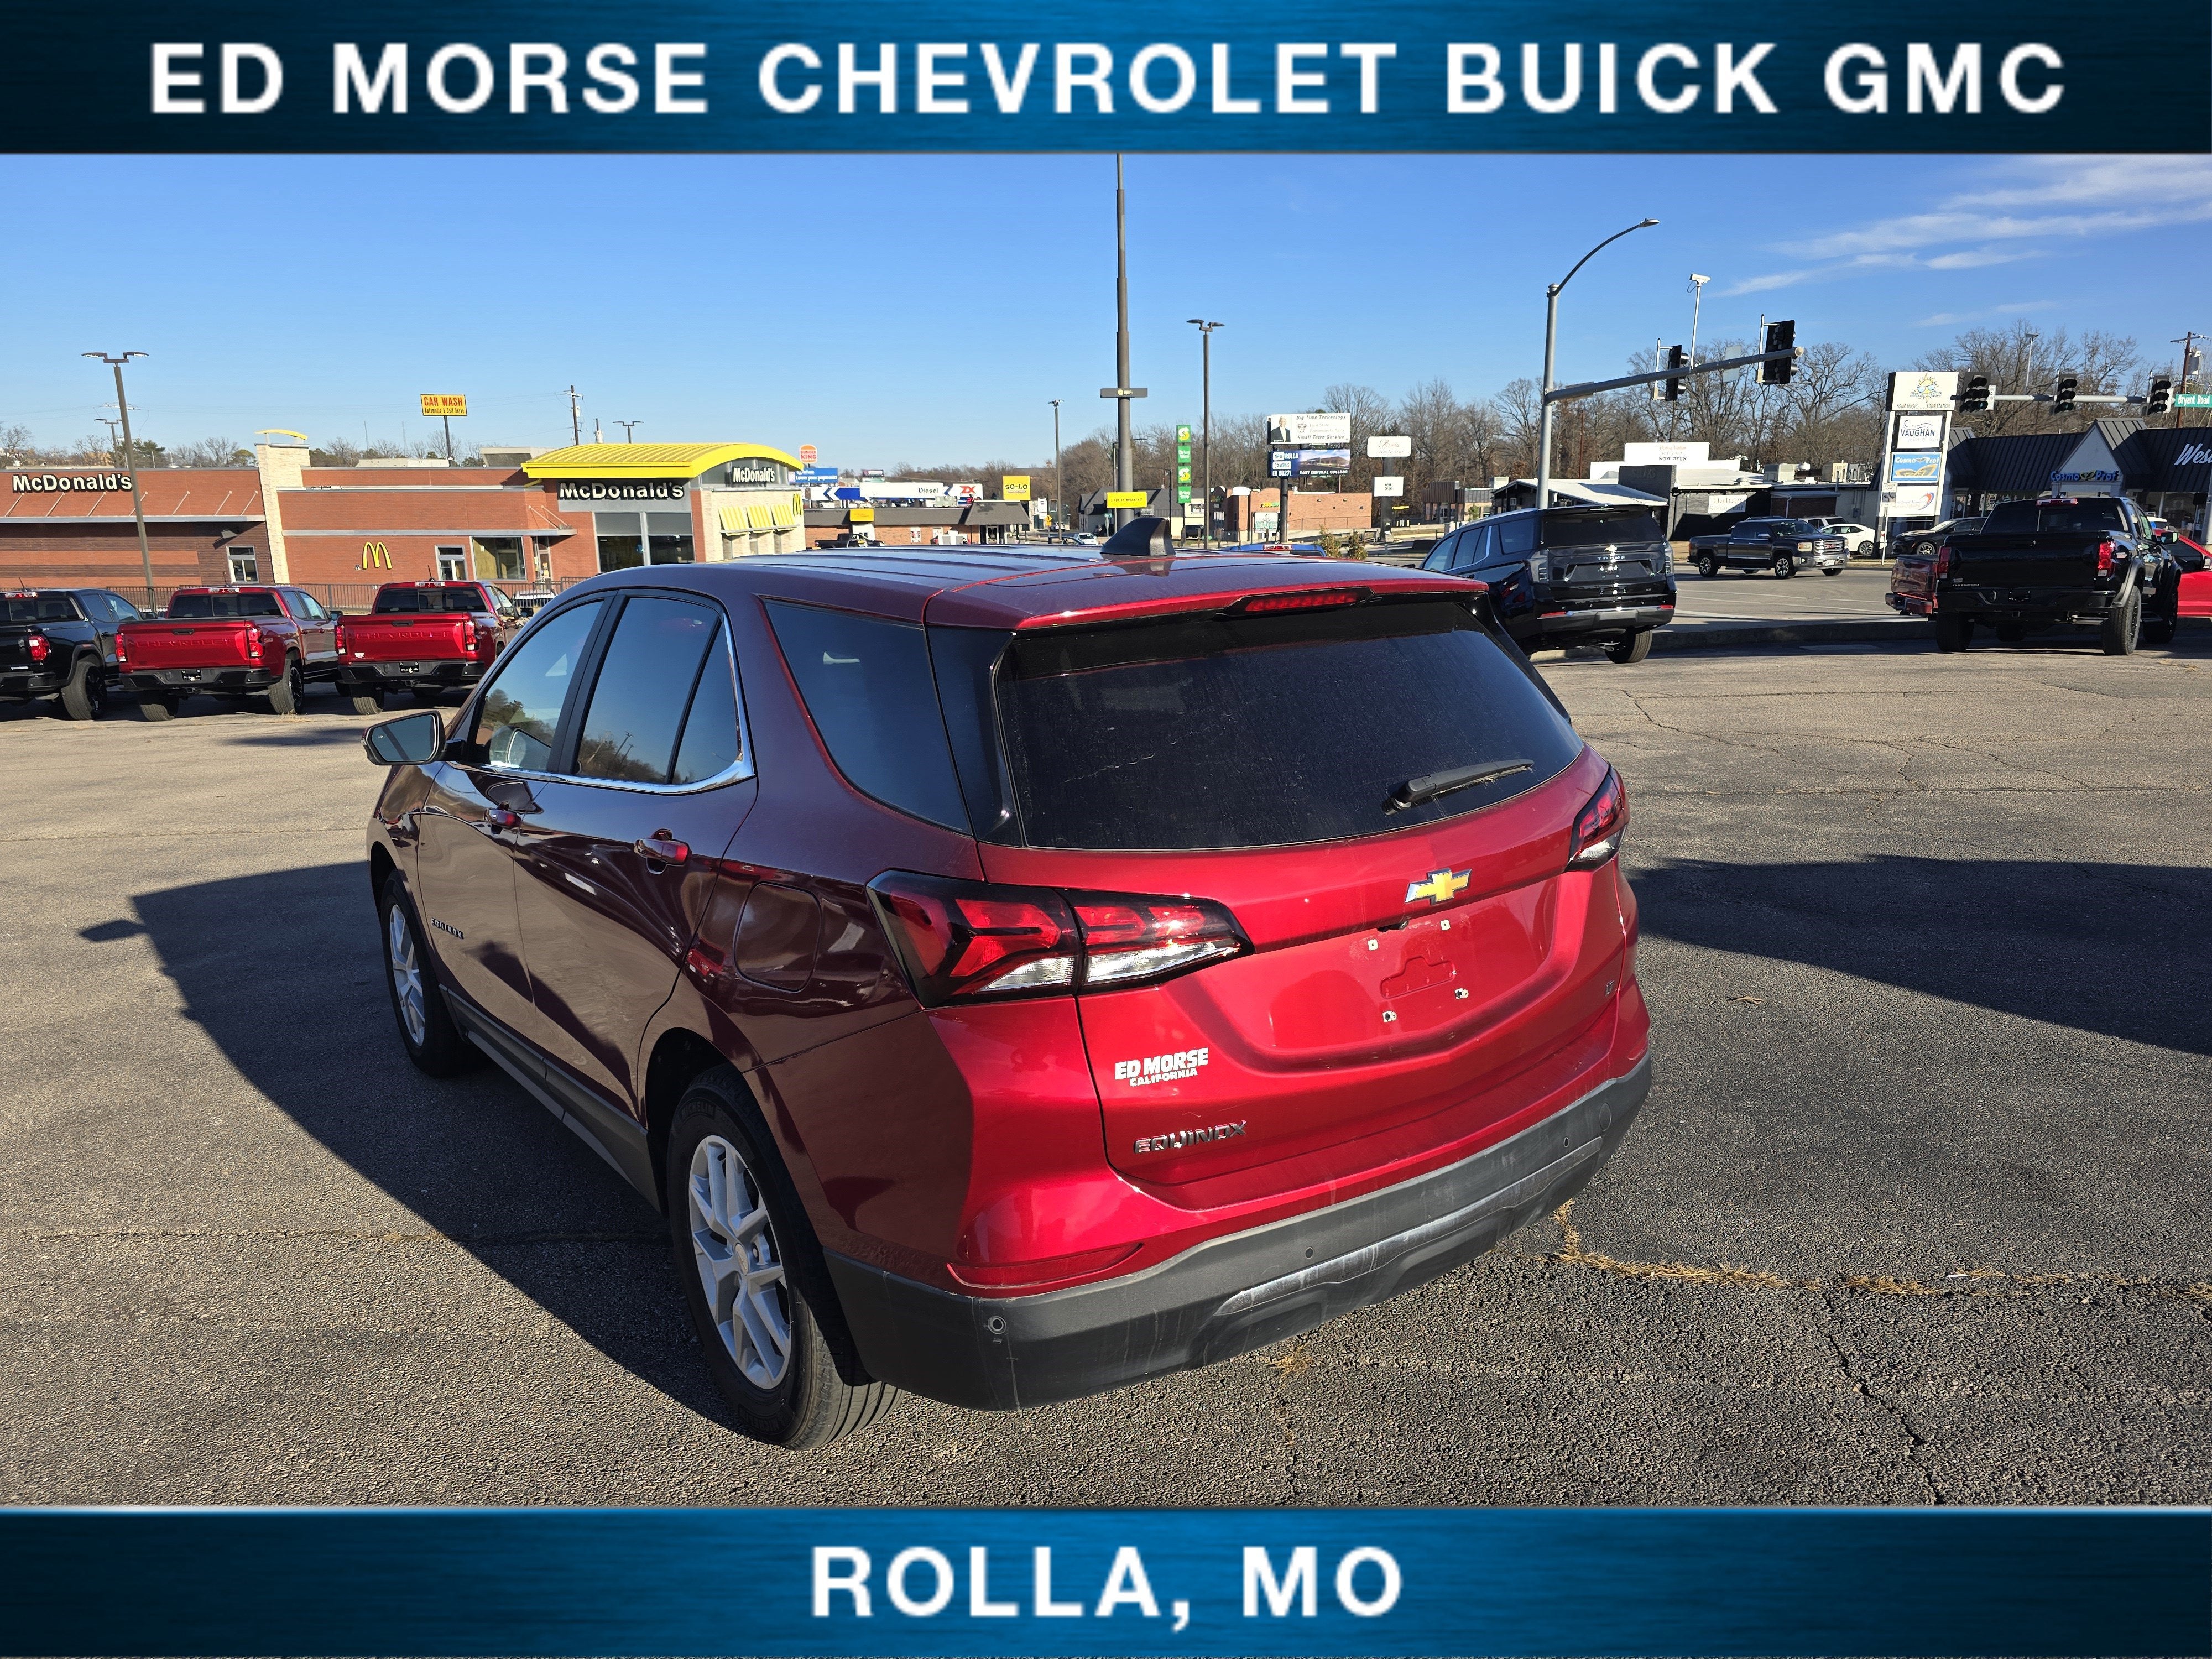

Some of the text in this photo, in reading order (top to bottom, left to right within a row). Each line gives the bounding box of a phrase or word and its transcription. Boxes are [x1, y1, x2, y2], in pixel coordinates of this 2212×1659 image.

[424, 397, 463, 406] CAR WASH
[2178, 395, 2210, 406] Bryant Road
[13, 474, 132, 491] McDonald's
[732, 467, 775, 483] McDonald's
[2051, 470, 2120, 482] Cosmo Prof
[560, 482, 684, 498] McDonald's
[430, 917, 464, 940] EQUINOX
[1115, 1047, 1209, 1080] ED MORSE
[1129, 1068, 1198, 1087] CALIFORNIA
[1134, 1120, 1247, 1154] EQUINOX
